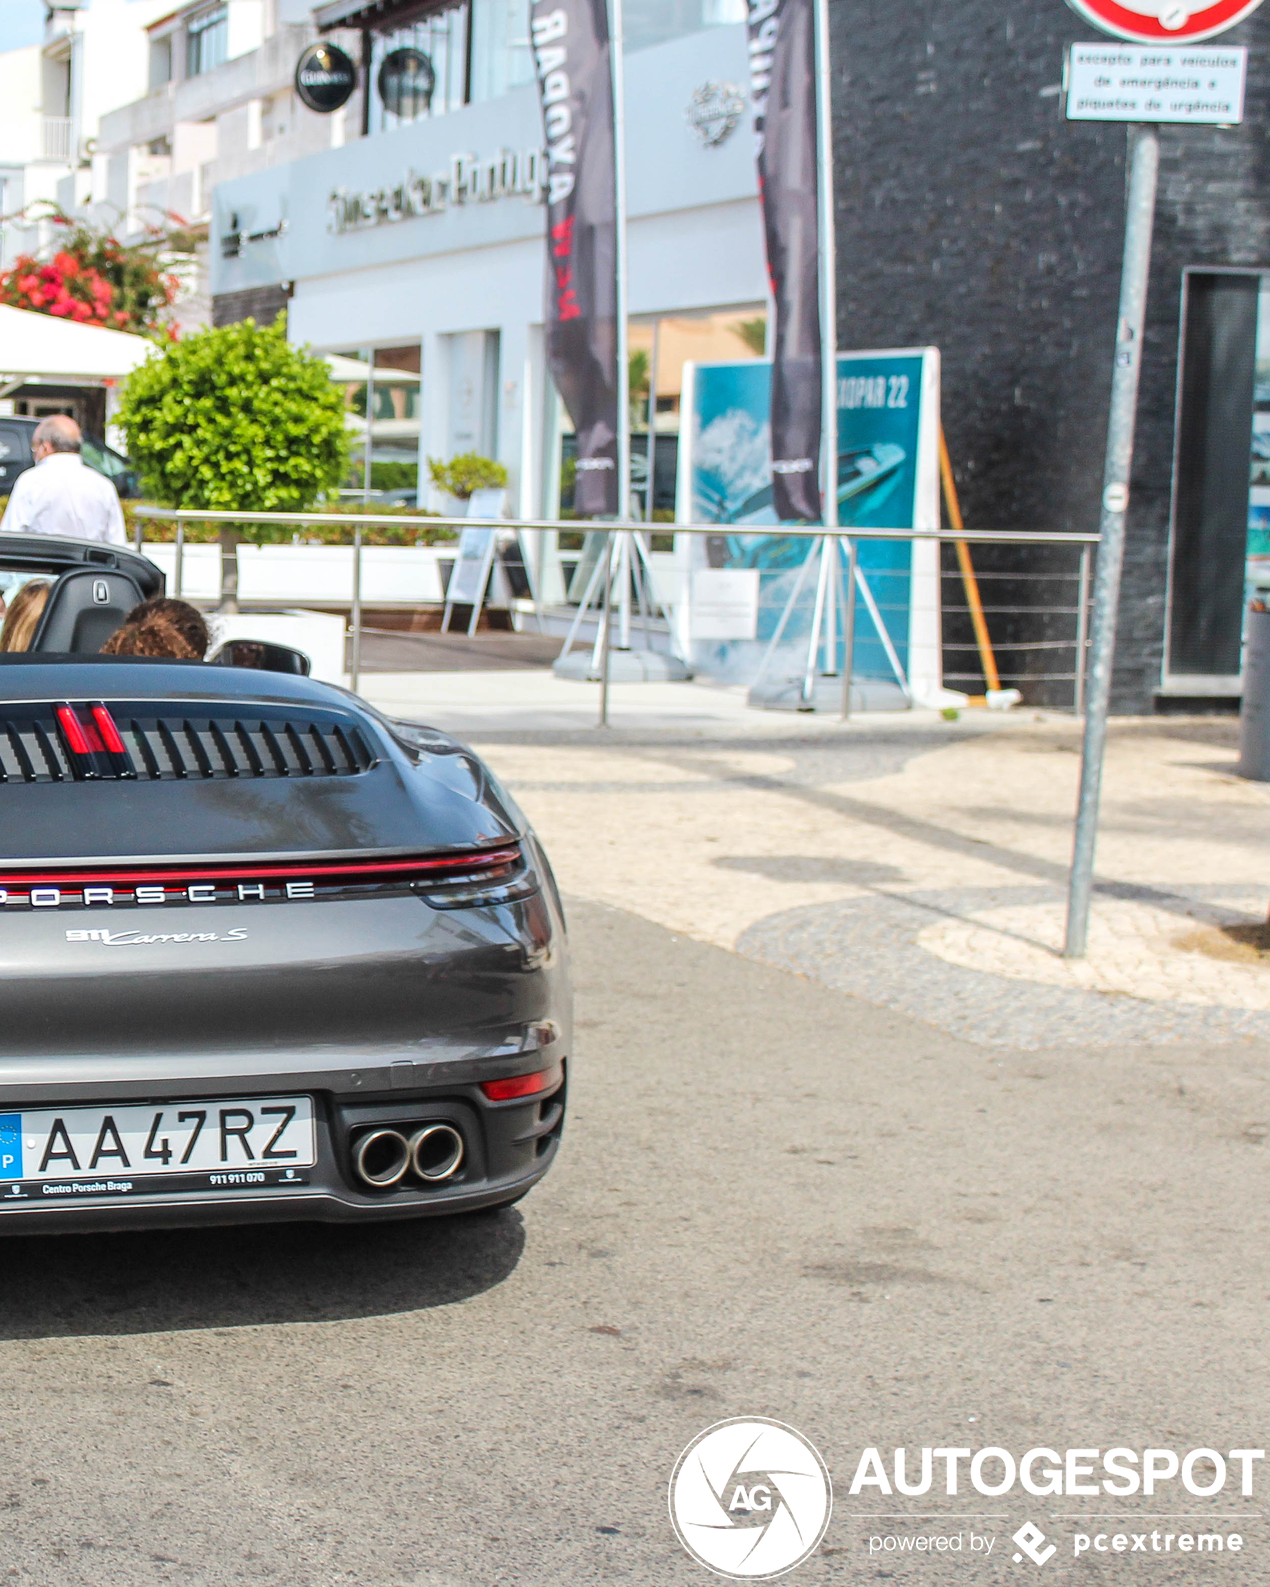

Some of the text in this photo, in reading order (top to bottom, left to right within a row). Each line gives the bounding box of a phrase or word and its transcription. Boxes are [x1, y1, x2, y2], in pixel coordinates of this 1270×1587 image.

[1140, 56, 1172, 68] para
[1094, 75, 1111, 88] de
[1208, 79, 1217, 90] e
[1144, 98, 1161, 112] de
[837, 374, 909, 409] XOPAR 22
[65, 927, 249, 947] 911 Carrera S
[1, 1155, 14, 1169] P
[42, 1181, 133, 1194] Centro Porsche Braga
